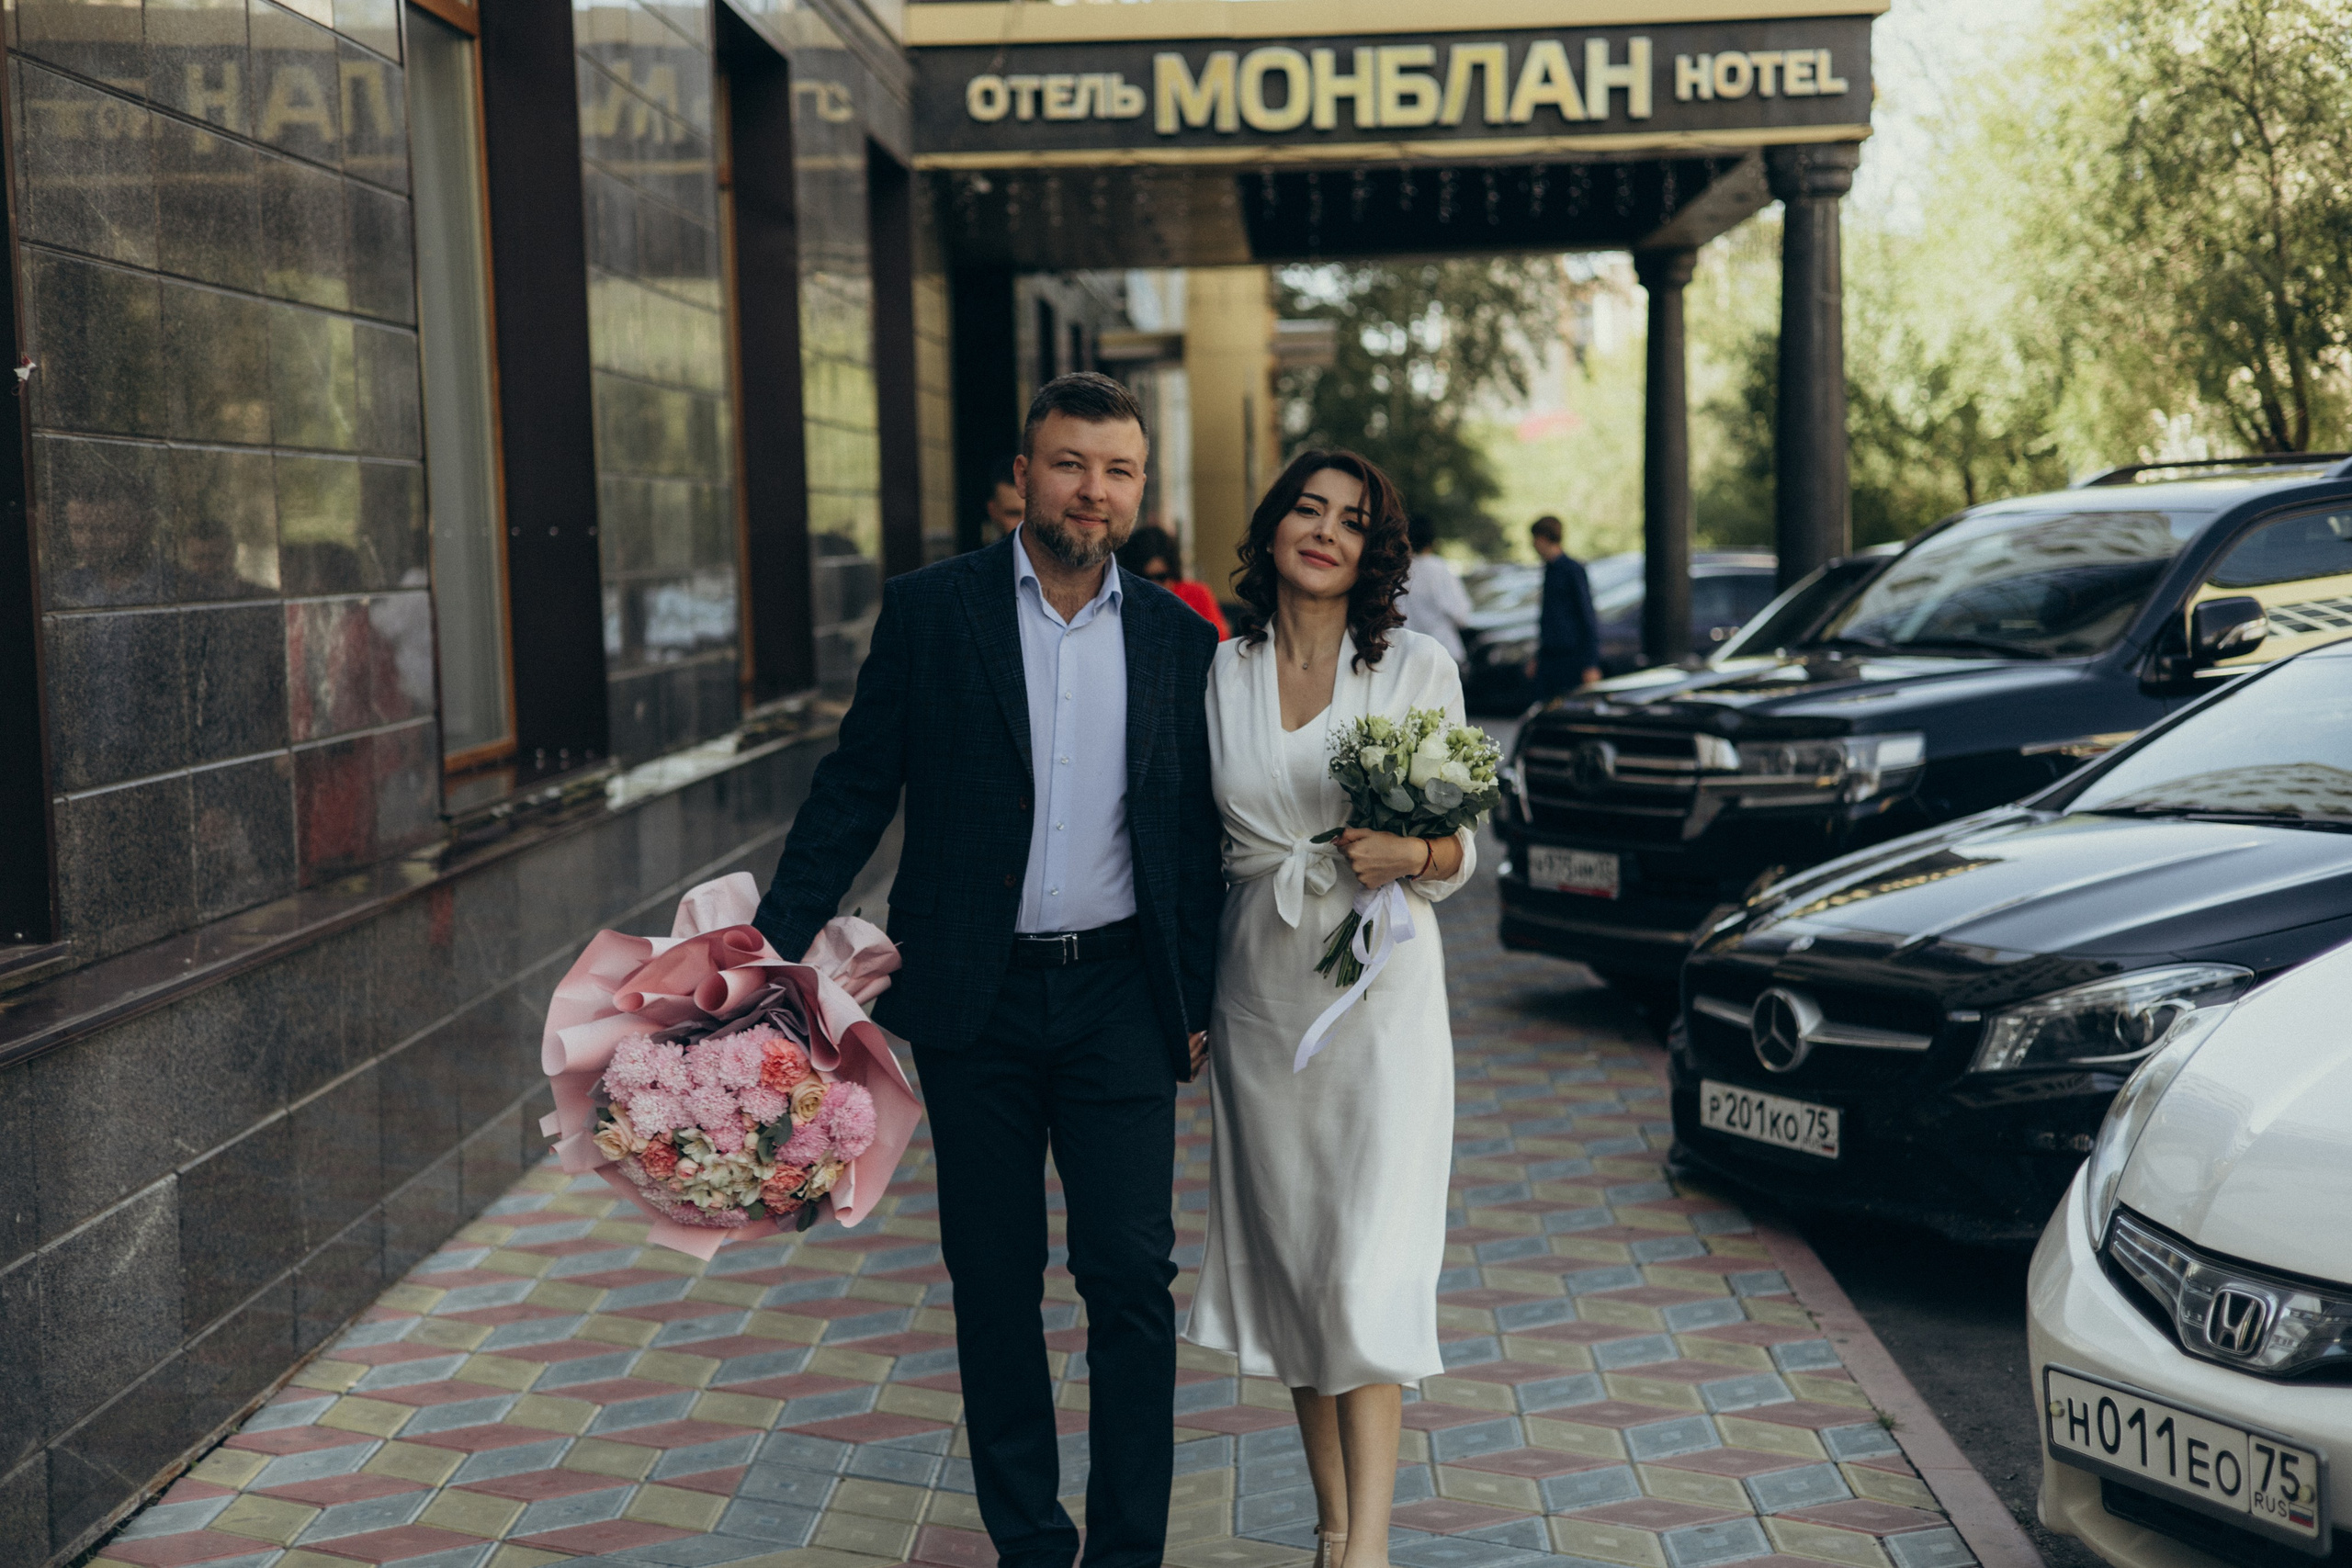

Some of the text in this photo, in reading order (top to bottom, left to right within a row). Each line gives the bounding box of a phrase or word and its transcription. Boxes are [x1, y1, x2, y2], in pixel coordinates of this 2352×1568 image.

[967, 36, 1848, 136] ОТЕЛЬ МОНБЛАН HOTEL
[2255, 1443, 2301, 1502] 75
[2254, 1491, 2288, 1518] RUS
